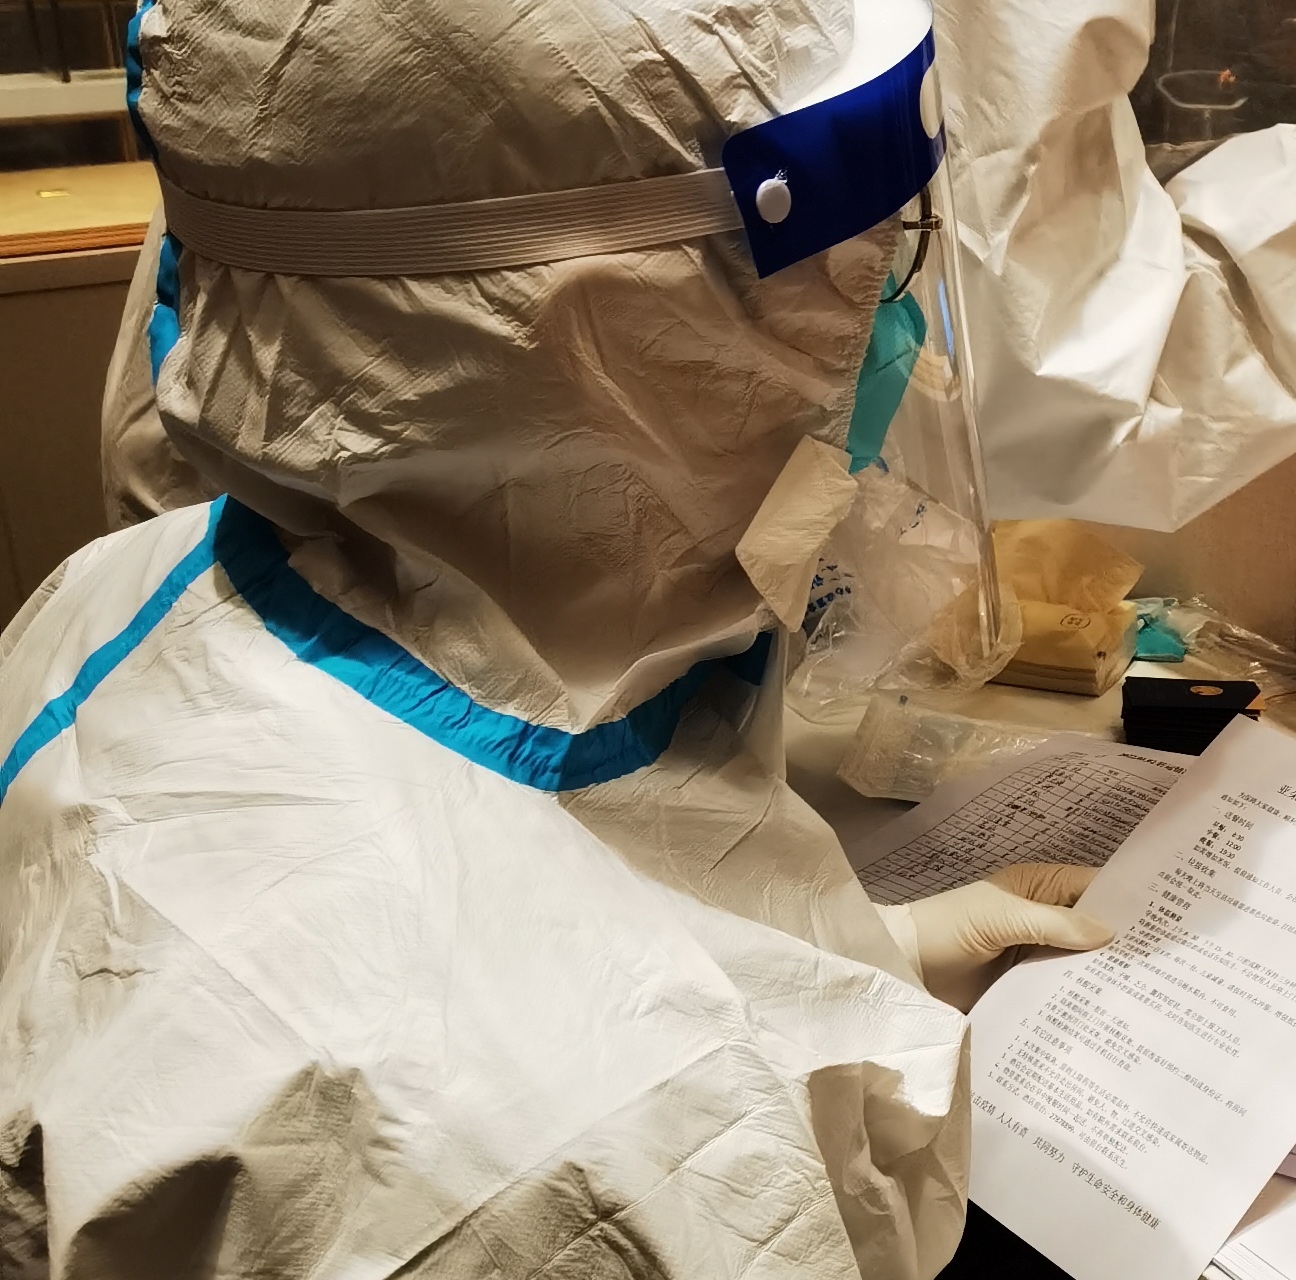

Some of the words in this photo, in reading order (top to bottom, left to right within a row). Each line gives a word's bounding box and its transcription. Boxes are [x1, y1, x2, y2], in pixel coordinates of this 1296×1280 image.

[1068, 1160, 1163, 1231] 守护生命安全和身体健康
